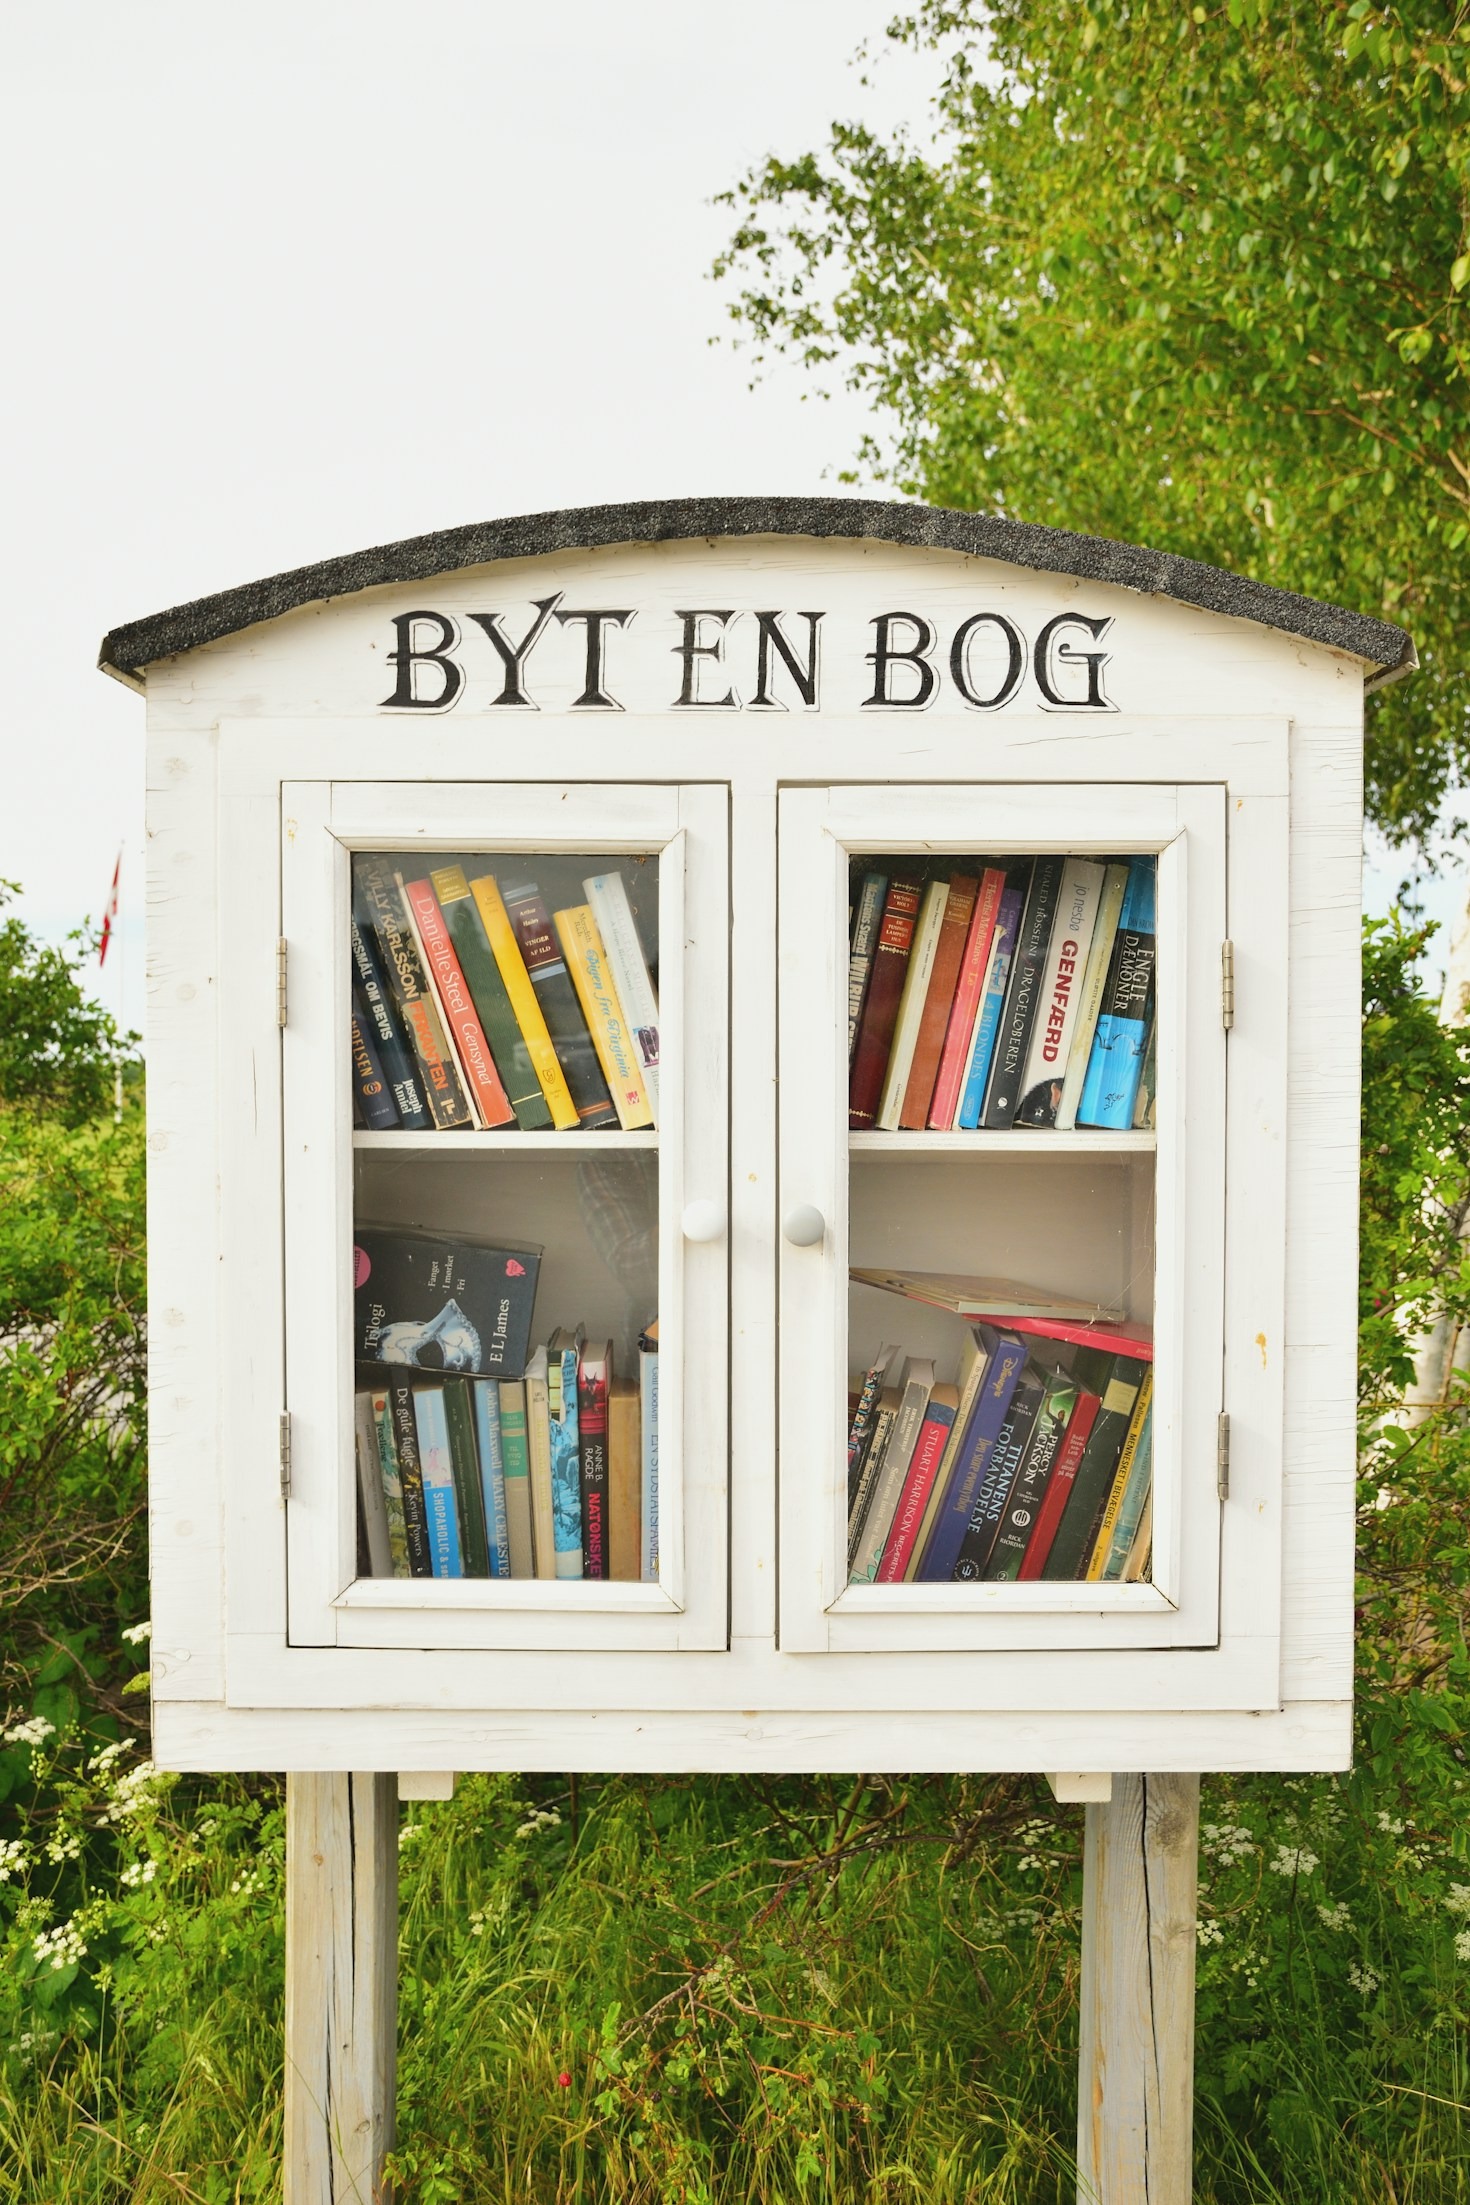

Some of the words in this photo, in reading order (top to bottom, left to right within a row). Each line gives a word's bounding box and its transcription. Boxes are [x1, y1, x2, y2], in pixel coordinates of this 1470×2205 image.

[377, 590, 636, 714] BYT
[669, 608, 826, 714] EN
[860, 611, 1122, 715] BOG
[1040, 864, 1054, 904] KHALED
[1074, 883, 1090, 896] jo
[518, 907, 537, 917] Arthur
[579, 911, 594, 944] Meredith
[1069, 899, 1086, 931] nesbø
[351, 917, 374, 979] ØRGSMÅL
[524, 934, 550, 948] VINGER
[540, 945, 552, 955] ILD
[855, 923, 871, 955] Sværd
[1028, 907, 1045, 957] HOSSEINI
[368, 871, 391, 909] VILLY
[381, 913, 419, 1000] KARLSSON
[409, 1000, 449, 1091] FIRKANTEN
[586, 949, 604, 990] Pigen
[1114, 935, 1140, 1010] DÆMONER
[1127, 948, 1155, 1002] ENGLE
[365, 981, 381, 1002] OM
[416, 896, 451, 972] Danielle
[441, 971, 469, 1014] Steel
[462, 1022, 492, 1086] Gensynet
[593, 992, 613, 1016] fra
[985, 1001, 994, 1009] 4
[1042, 939, 1079, 1063] GENFÆRD
[372, 1003, 394, 1040] BEVIS
[1004, 966, 1035, 1074] DRAGELØBEREN
[607, 1018, 630, 1078] Virginia
[970, 1014, 993, 1079] BLONDES
[393, 1083, 413, 1114] Amiel
[402, 1078, 424, 1114] Joseph
[428, 1261, 439, 1287] Fanget
[456, 1278, 466, 1291] Fri
[363, 1303, 386, 1349] Trilogi
[492, 1298, 510, 1340] James
[490, 1353, 503, 1363] E
[491, 1343, 505, 1352] L
[993, 1357, 1019, 1397] Disney's
[397, 1388, 408, 1405] De
[486, 1388, 498, 1417] John
[396, 1408, 413, 1433] gule
[1132, 1401, 1146, 1429] Pallesen
[400, 1436, 416, 1467] fugle
[489, 1420, 503, 1469] Maxwell
[594, 1445, 603, 1472] ANNE
[918, 1428, 939, 1473] STUART
[975, 1437, 993, 1452] Den
[1024, 1414, 1057, 1485] JACKSON
[1037, 1434, 1059, 1477] PERCY
[1117, 1433, 1137, 1481] MENNESKET
[584, 1447, 594, 1480] RAGDE
[595, 1474, 603, 1482] B.
[967, 1422, 1015, 1533] FORBANDELSE
[969, 1453, 984, 1473] store
[492, 1473, 506, 1511] MARY
[953, 1472, 977, 1513] eventyrbog
[986, 1444, 1023, 1521] TITANENS
[409, 1493, 420, 1521] Kevin
[899, 1474, 926, 1533] HARRISON
[1103, 1484, 1122, 1530] BEVÆGELSE
[413, 1523, 422, 1557] Powers
[433, 1492, 450, 1554] SHOPAHOLIC
[1008, 1534, 1022, 1543] RICK
[495, 1514, 509, 1576] CELESTE
[1000, 1538, 1026, 1549] RIORDAN
